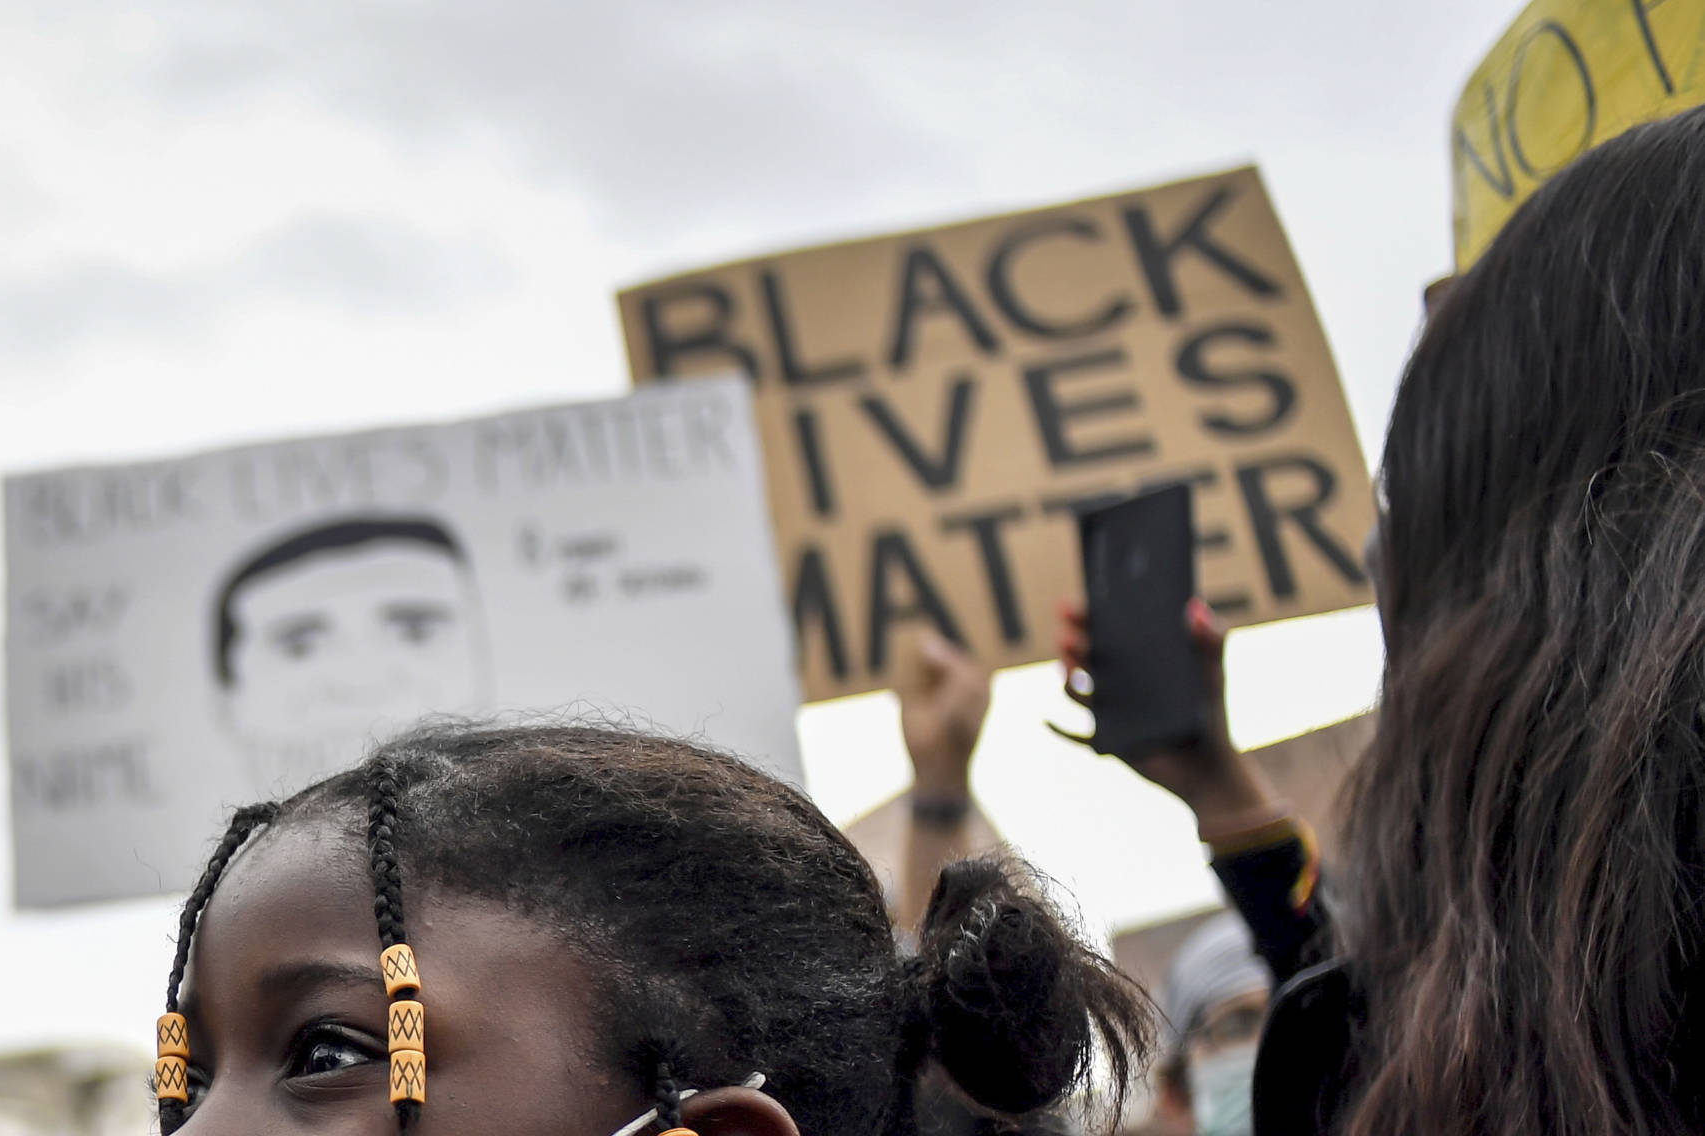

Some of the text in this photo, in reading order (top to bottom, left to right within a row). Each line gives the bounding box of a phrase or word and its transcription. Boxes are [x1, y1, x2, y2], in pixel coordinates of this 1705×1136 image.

[641, 184, 1287, 388] BLACK
[473, 388, 736, 497] MATTER
[793, 322, 1297, 518] IVES
